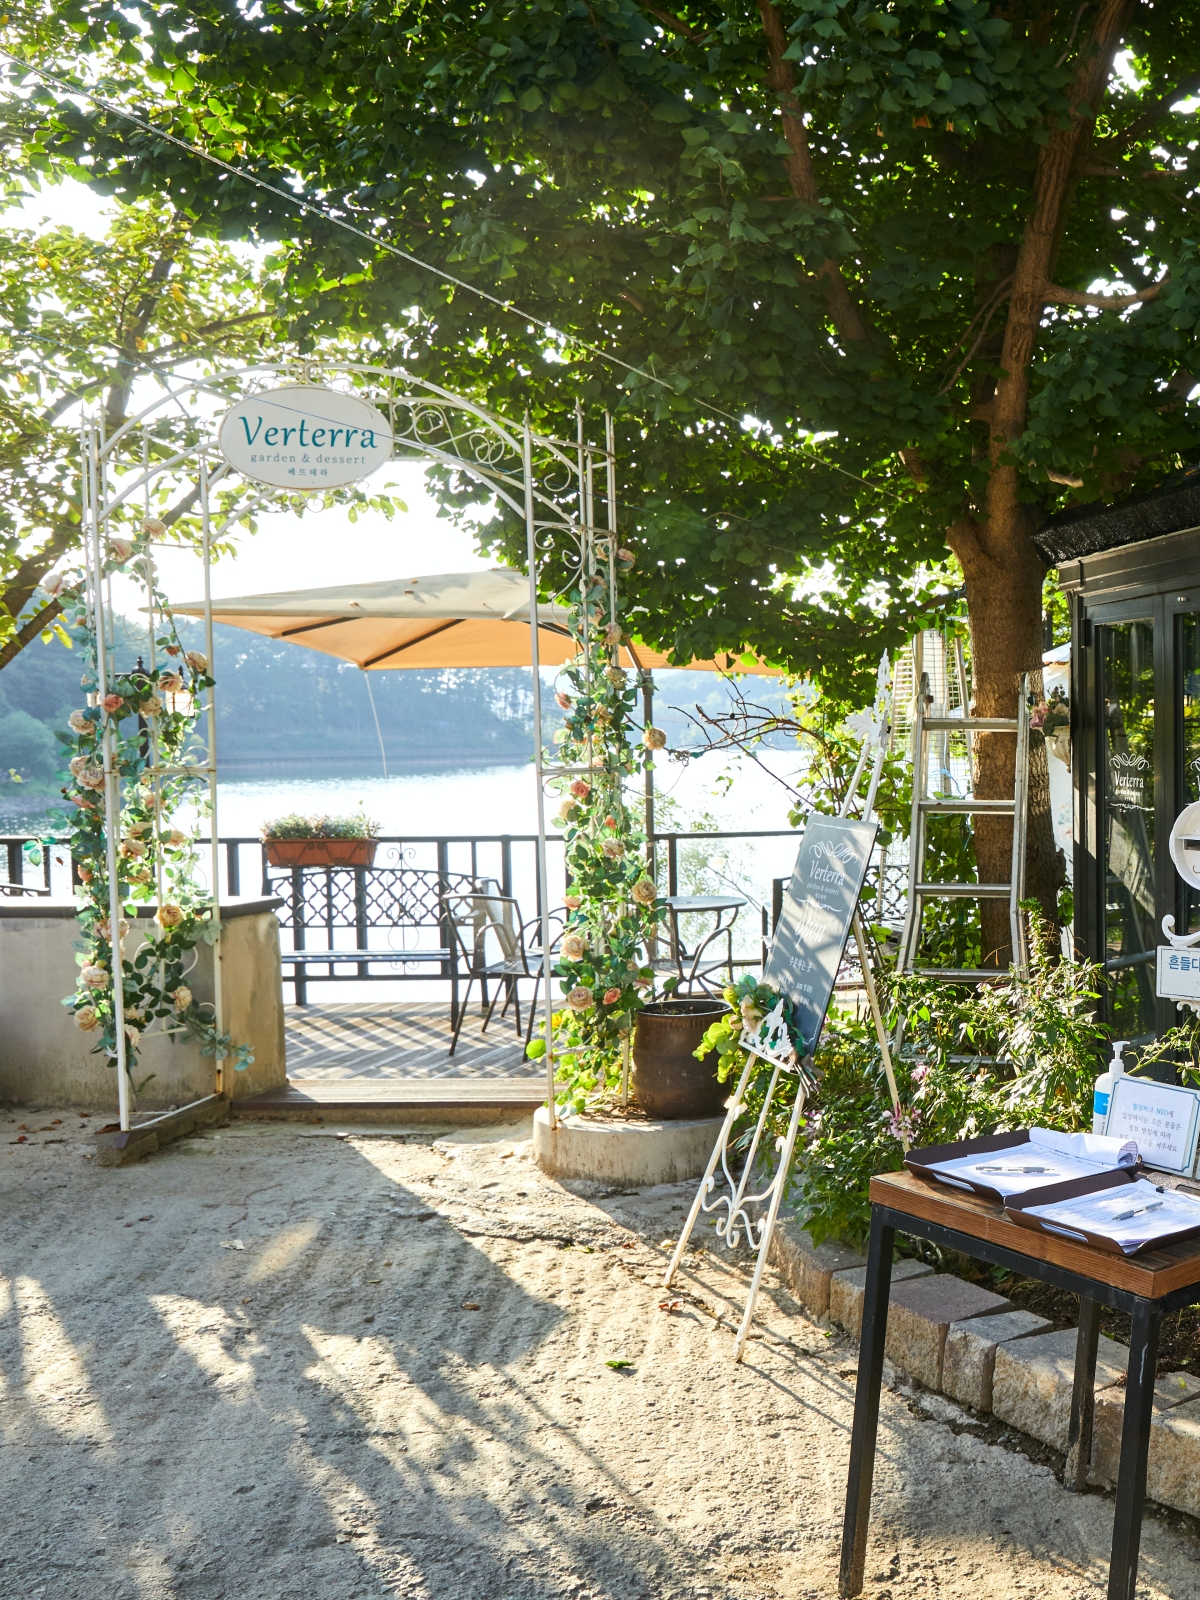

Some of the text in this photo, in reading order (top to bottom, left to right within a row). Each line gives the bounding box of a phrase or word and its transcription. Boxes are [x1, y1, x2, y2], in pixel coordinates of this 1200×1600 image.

[238, 416, 378, 449] Verterra
[250, 453, 366, 465] garden & dessert
[1114, 770, 1145, 789] Verterra
[810, 860, 845, 886] Verterra
[795, 916, 827, 948] open
